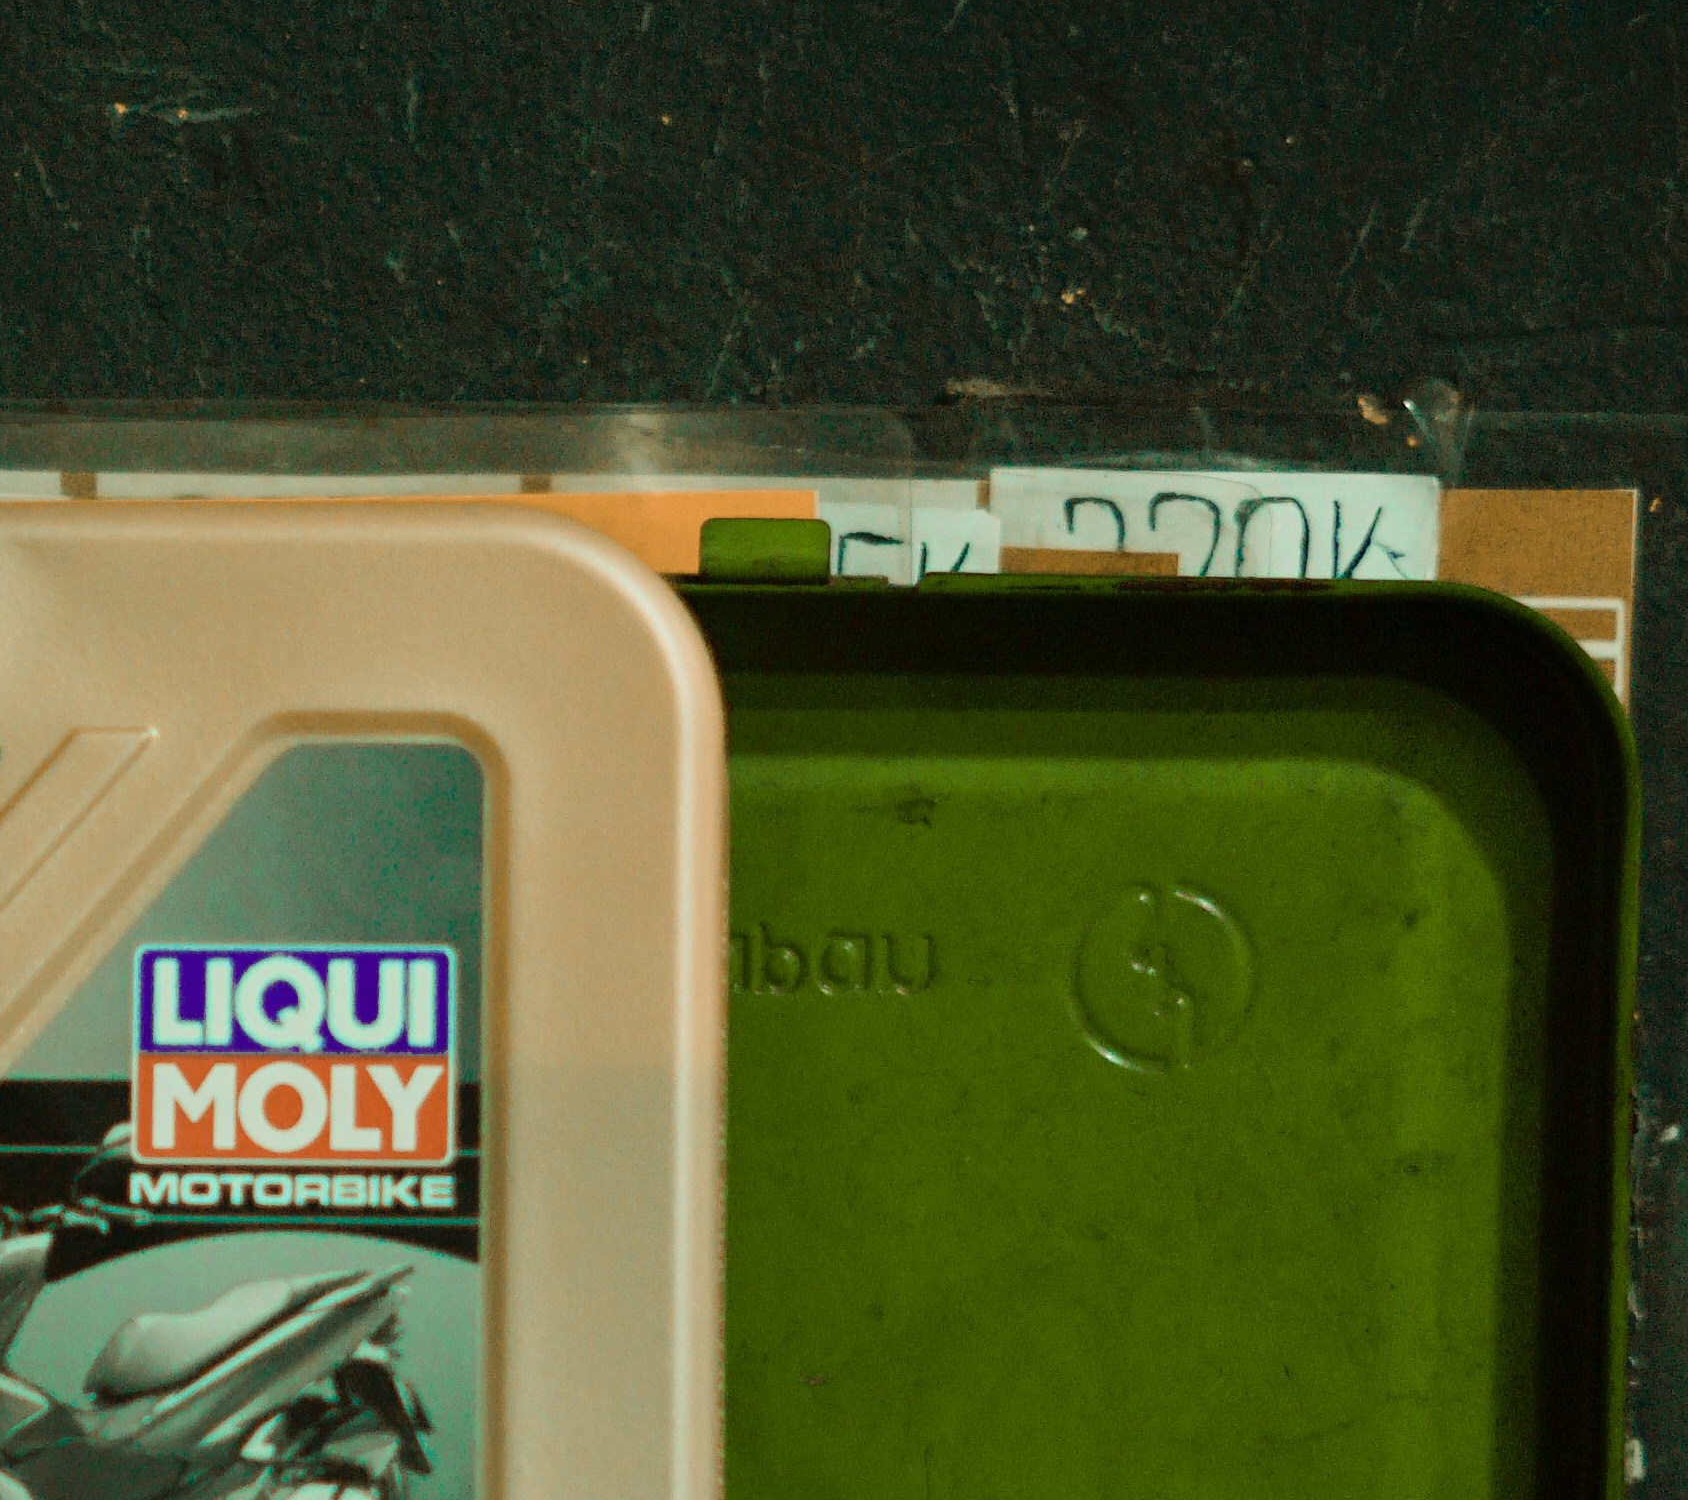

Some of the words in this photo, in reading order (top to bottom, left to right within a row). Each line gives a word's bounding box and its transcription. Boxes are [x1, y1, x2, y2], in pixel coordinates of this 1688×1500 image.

[152, 955, 437, 1053] LIQUI
[151, 1060, 445, 1153] MOLY
[128, 1172, 456, 1207] MOTORBIKE
